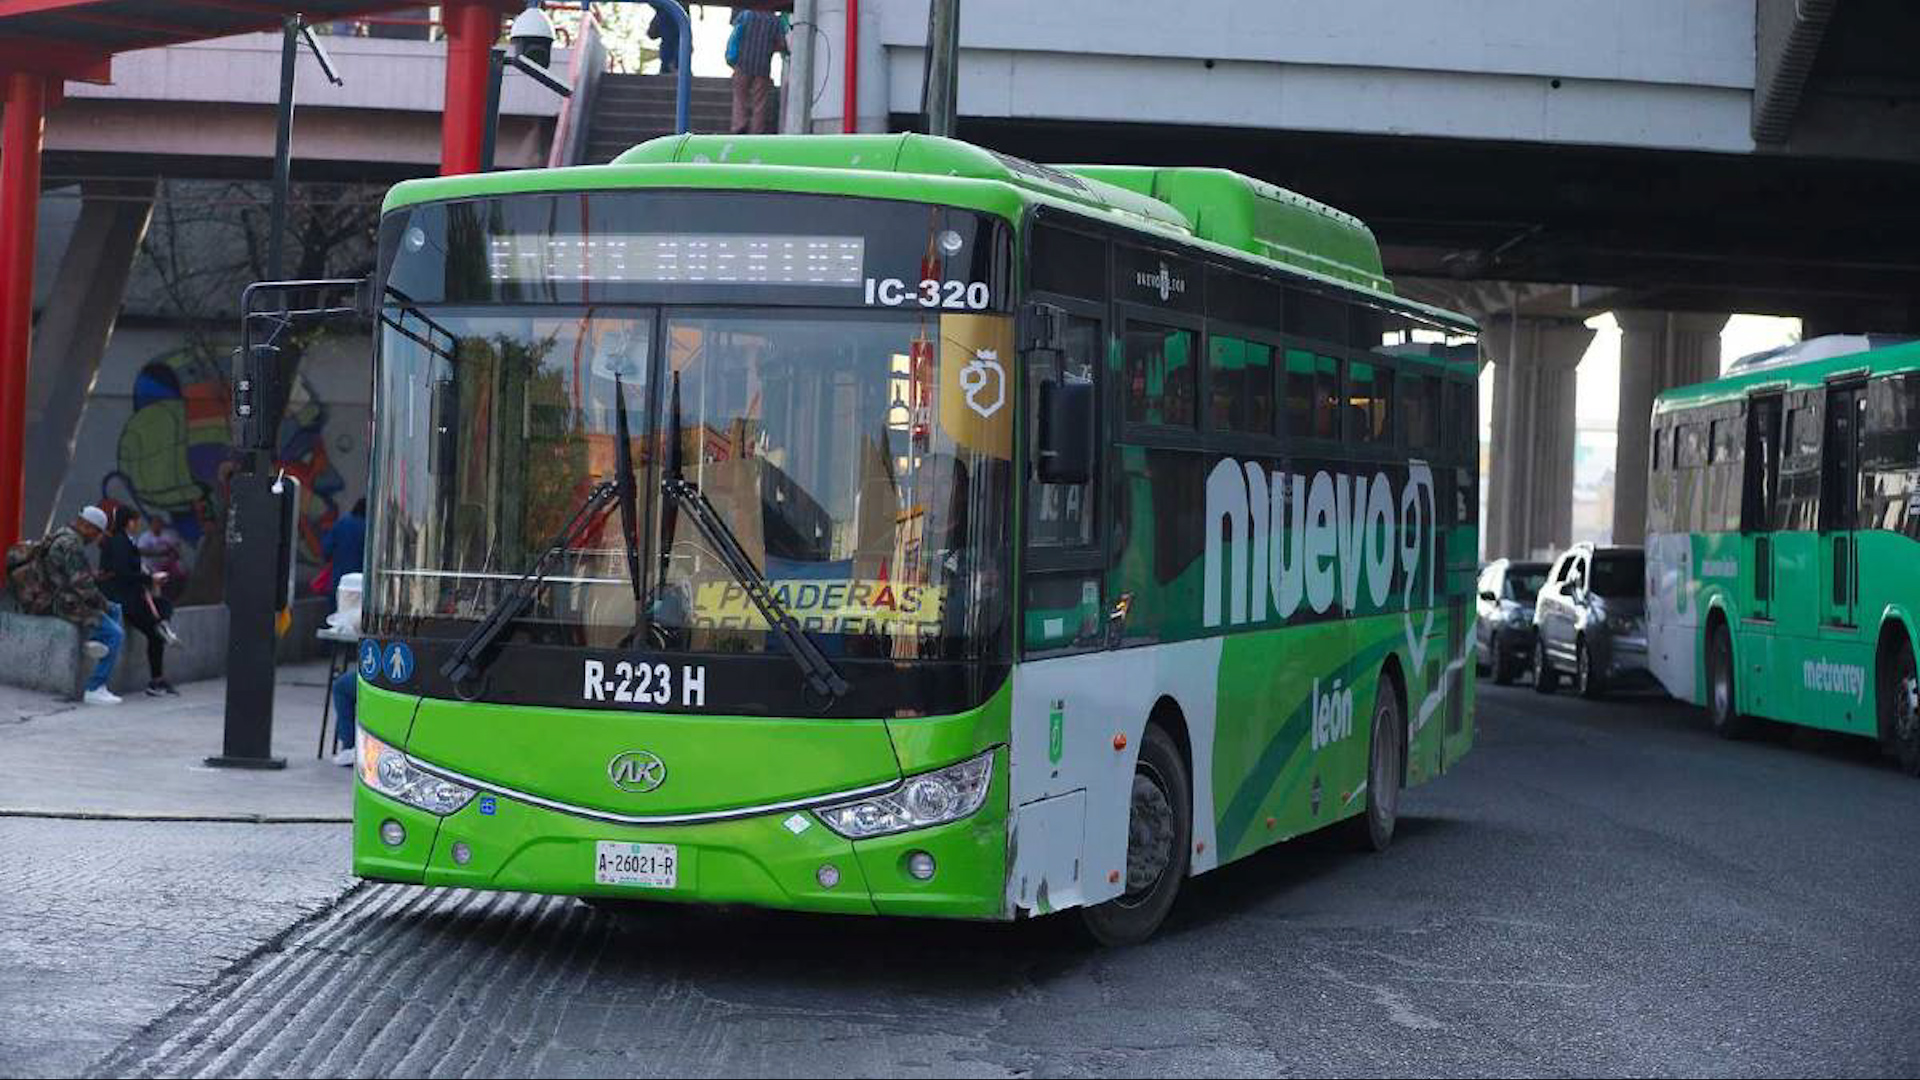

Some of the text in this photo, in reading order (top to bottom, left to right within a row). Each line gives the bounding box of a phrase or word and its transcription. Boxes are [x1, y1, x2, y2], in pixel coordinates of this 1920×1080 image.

[864, 278, 990, 310] IC-320
[583, 659, 706, 707] R-223 H
[1311, 676, 1354, 752] león
[598, 853, 674, 876] A-26021-R
